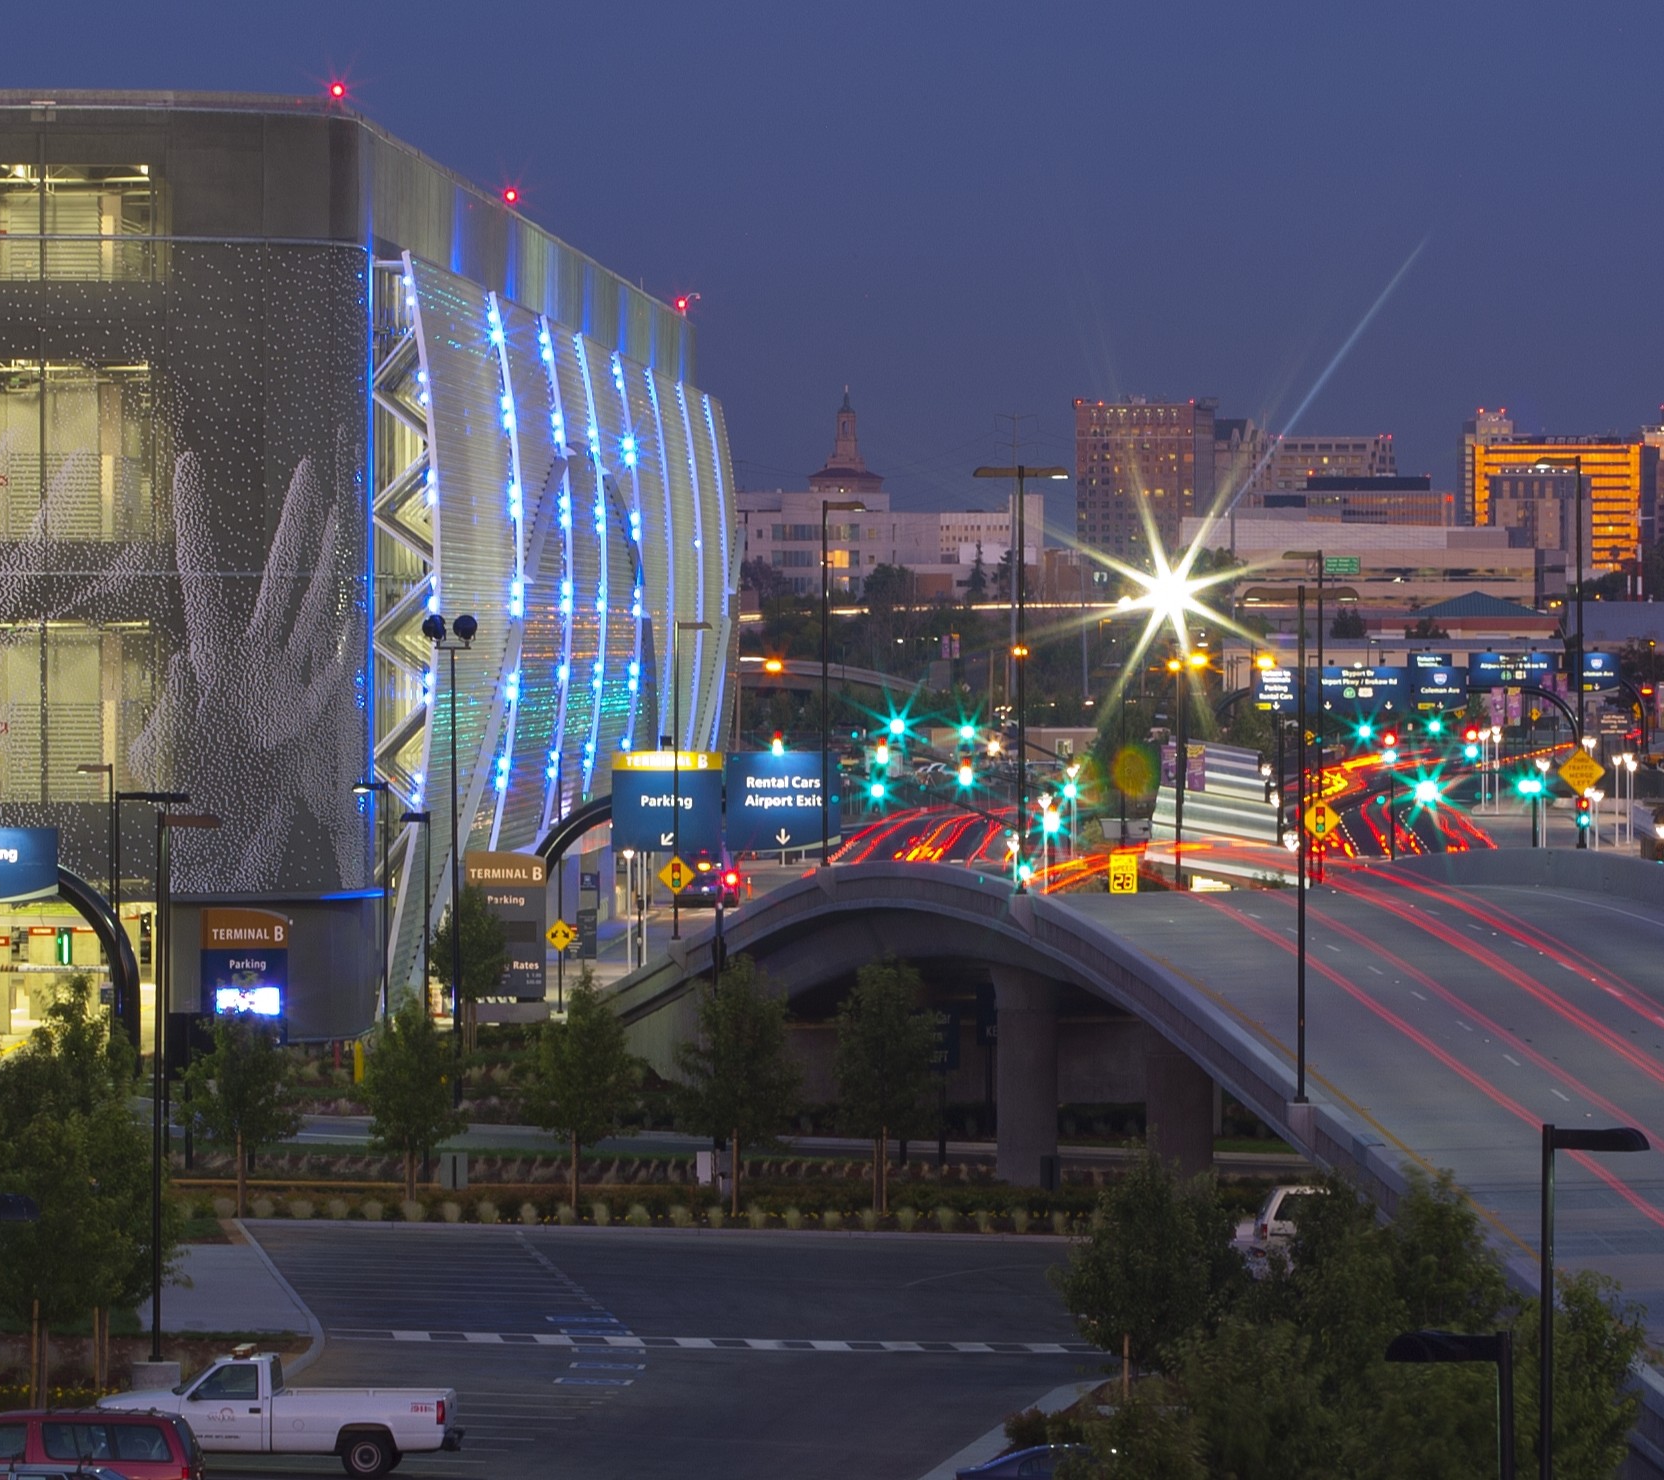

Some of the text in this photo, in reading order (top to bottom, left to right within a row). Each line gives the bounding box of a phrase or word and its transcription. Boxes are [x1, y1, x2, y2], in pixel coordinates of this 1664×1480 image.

[1264, 685, 1288, 693] Parking
[626, 754, 708, 769] TERMINAL B
[746, 775, 821, 788] Rental Cars
[640, 794, 693, 809] Parking
[744, 794, 823, 809] Airport Exit
[470, 866, 543, 881] TERMINAL B
[1114, 874, 1134, 889] 28
[487, 895, 525, 906] Parking
[212, 926, 284, 942] TERMINAL B
[229, 959, 266, 971] Parking
[513, 961, 539, 970] Rates
